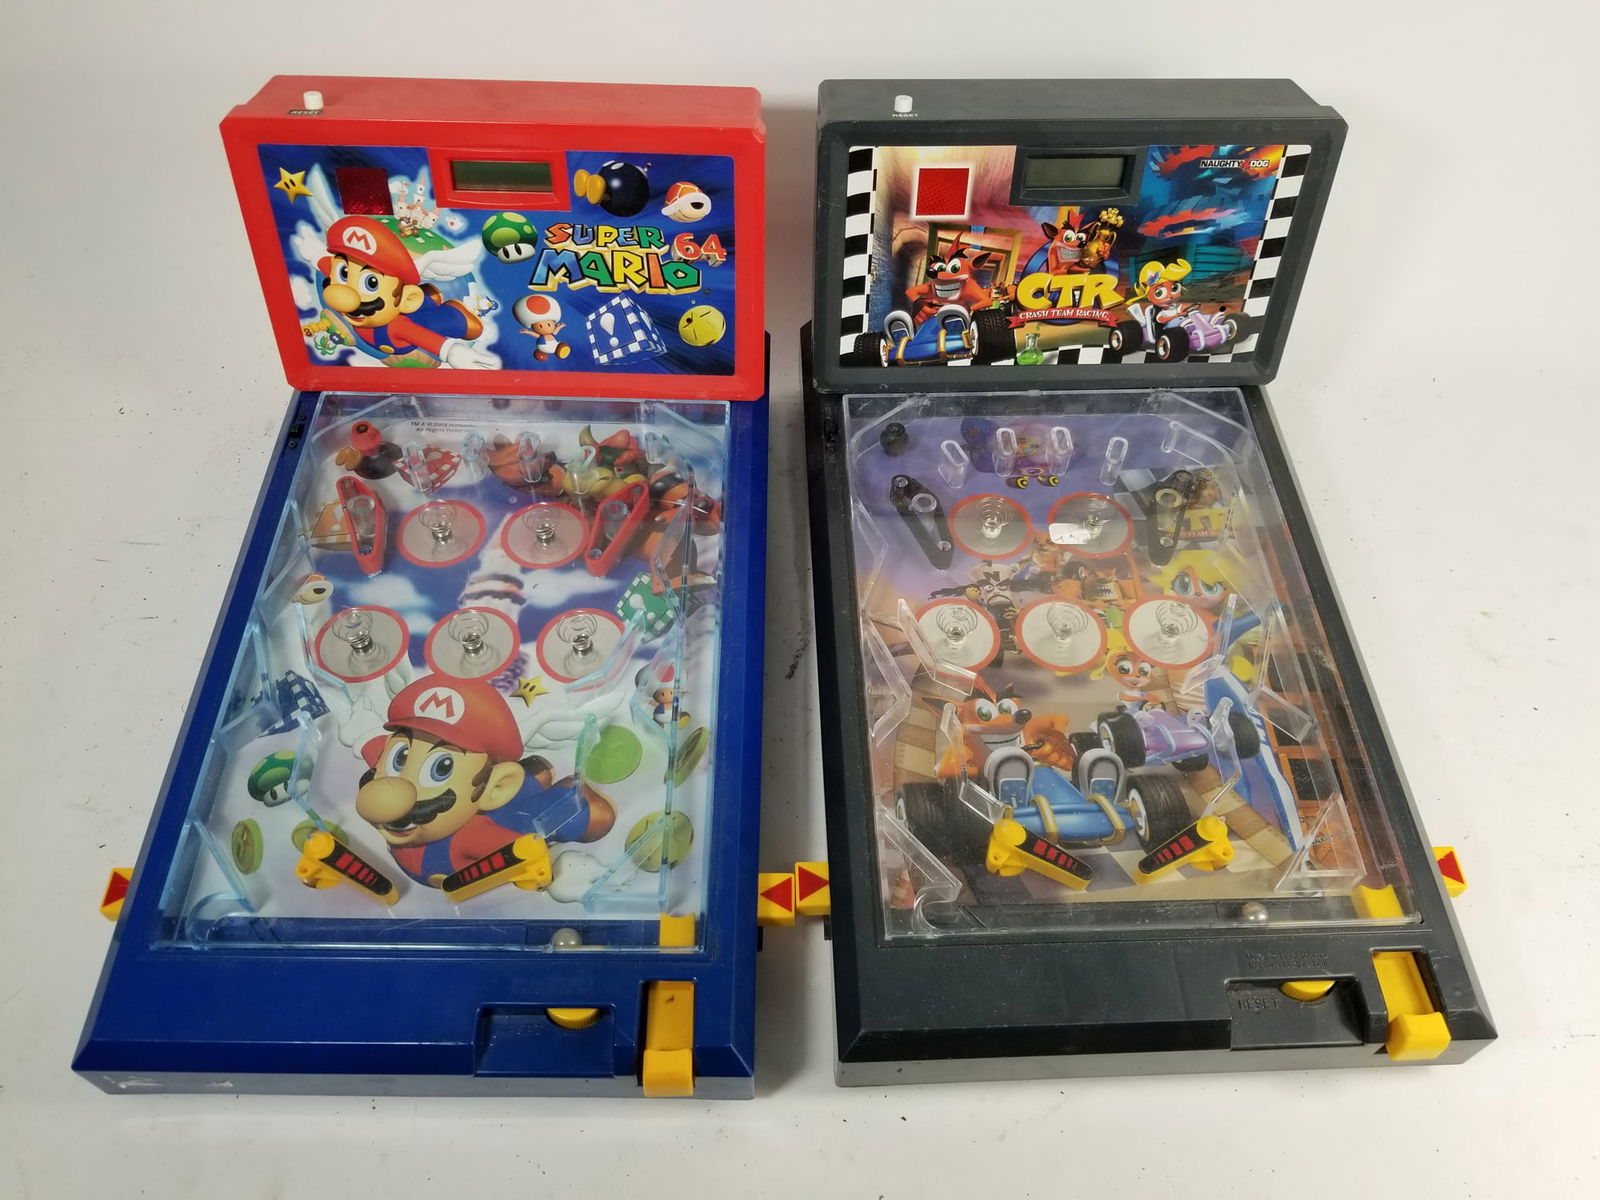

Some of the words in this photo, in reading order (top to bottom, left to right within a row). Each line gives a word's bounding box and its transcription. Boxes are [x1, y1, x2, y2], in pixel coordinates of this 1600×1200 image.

[1200, 160, 1242, 168] NAUGHTY
[1250, 160, 1270, 168] DOG
[544, 223, 669, 251] SUPER
[672, 233, 727, 267] 64
[528, 248, 702, 295] MARIO
[1017, 272, 1124, 310] CTR
[1019, 310, 1048, 319] CRASH
[1076, 310, 1109, 319] RACING
[1238, 997, 1278, 1010] RESET
